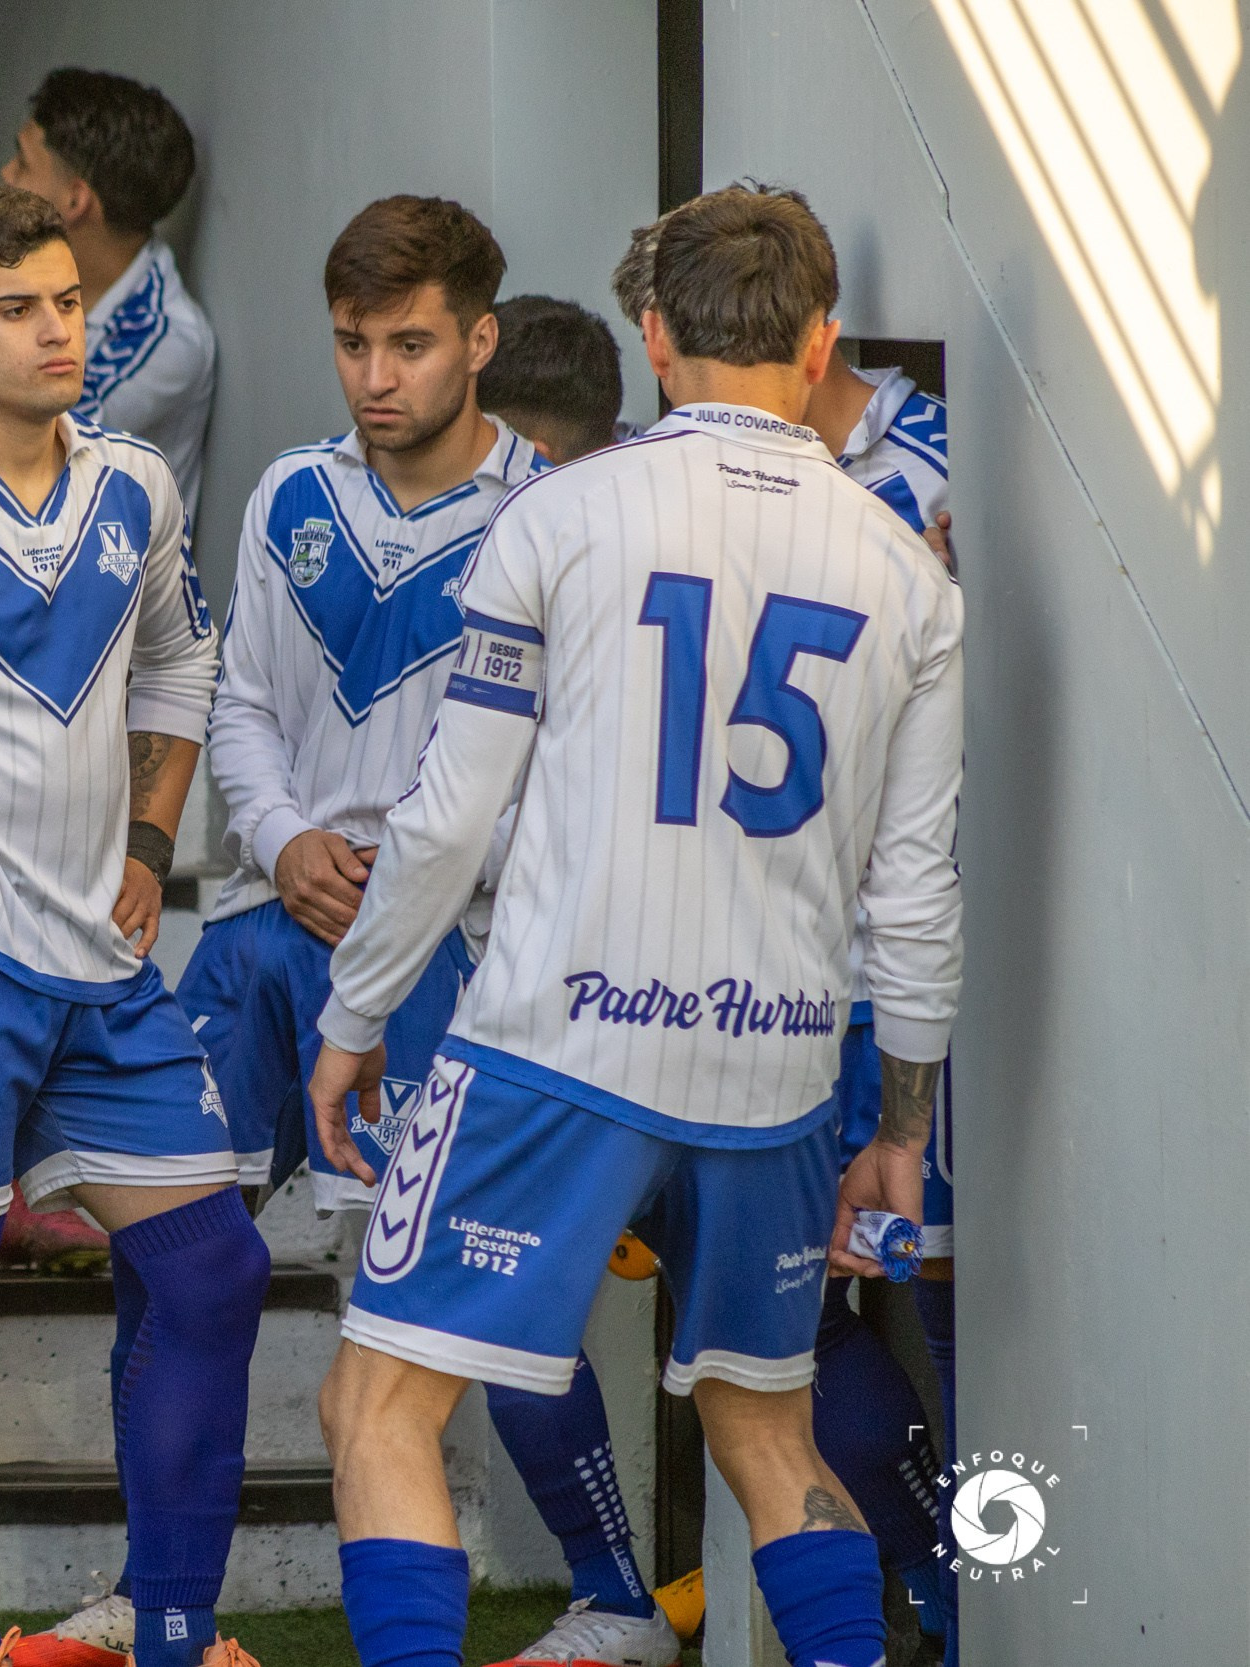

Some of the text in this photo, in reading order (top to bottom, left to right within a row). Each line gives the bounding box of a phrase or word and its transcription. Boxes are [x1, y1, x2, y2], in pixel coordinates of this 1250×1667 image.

[695, 409, 814, 443] JULIO COVARRUBIAS
[716, 463, 802, 487] Padre Hurtado
[31, 553, 61, 564] Desde
[489, 641, 524, 660] DESDE
[483, 656, 522, 682] 1912
[637, 571, 870, 839] 15
[563, 970, 703, 1030] Padre
[449, 1216, 541, 1247] Liderando
[464, 1233, 521, 1257] Desde
[462, 1249, 519, 1276] 1912
